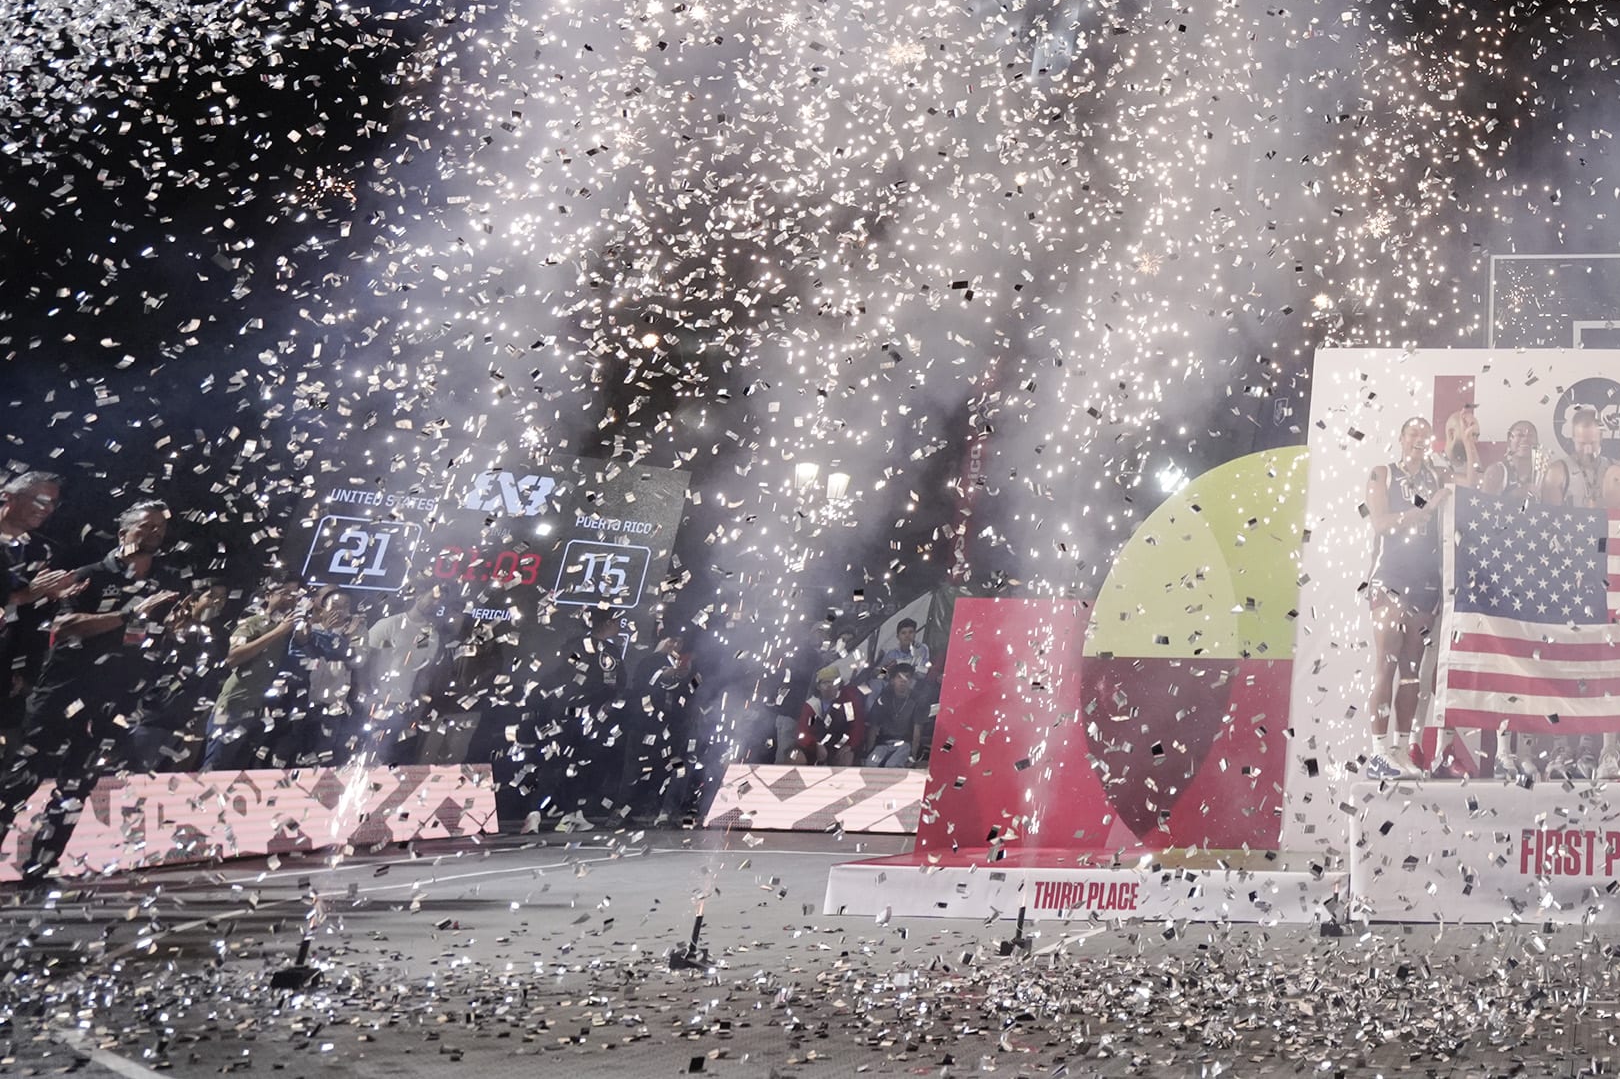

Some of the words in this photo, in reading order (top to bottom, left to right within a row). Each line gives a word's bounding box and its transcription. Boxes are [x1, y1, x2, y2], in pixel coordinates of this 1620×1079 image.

[330, 488, 383, 506] UNITED
[622, 520, 652, 535] RICO
[328, 530, 391, 577] 21
[434, 544, 542, 585] 01:03
[573, 552, 631, 595] 15
[1520, 828, 1596, 876] FIRST
[1033, 881, 1085, 910] THIRD
[1086, 882, 1140, 910] PLACE
